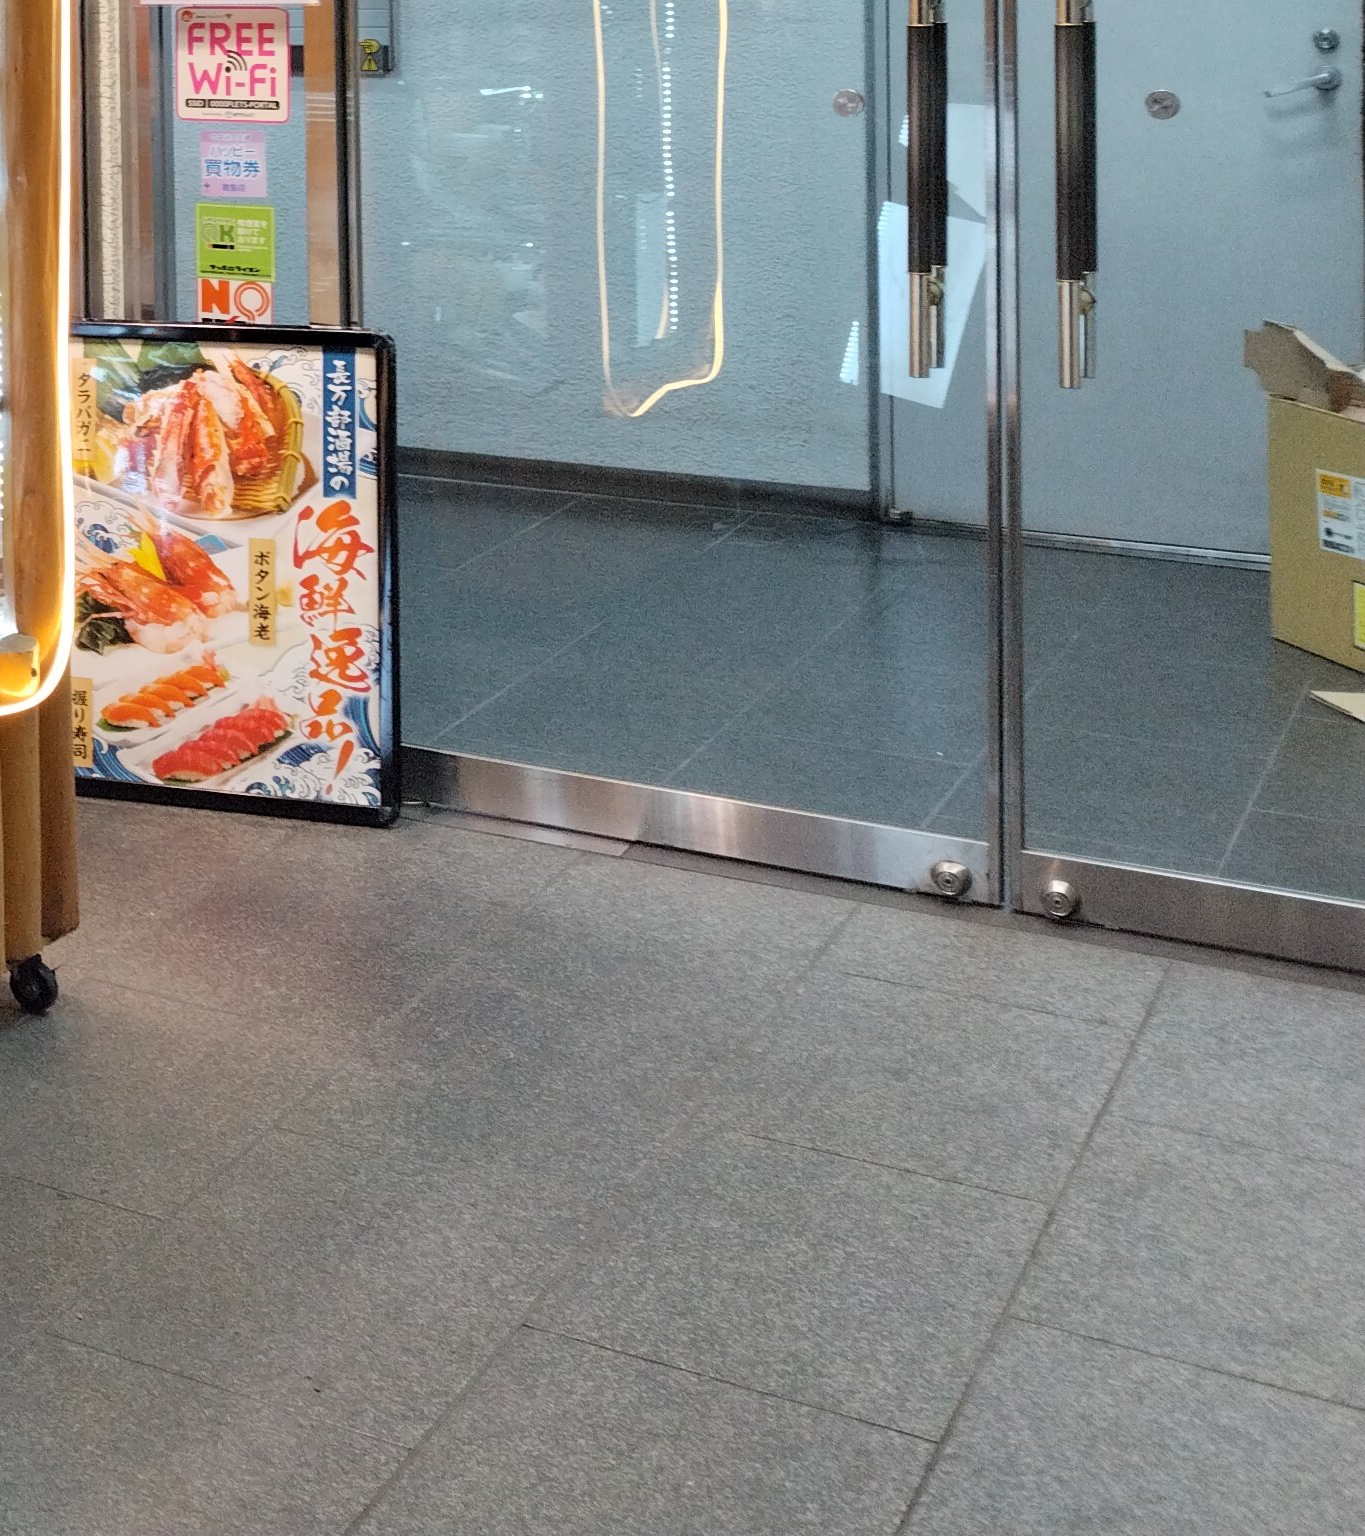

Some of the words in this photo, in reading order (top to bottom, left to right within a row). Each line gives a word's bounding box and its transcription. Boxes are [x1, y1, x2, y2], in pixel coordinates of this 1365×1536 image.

[187, 22, 276, 56] FREE
[187, 62, 277, 97] Wi-Fi
[204, 158, 261, 178] 買物券
[76, 371, 93, 454] タラバガニ
[323, 359, 355, 492] 長万部酒場の
[251, 550, 273, 642] ボタン海老
[72, 689, 89, 761] 握り寿司
